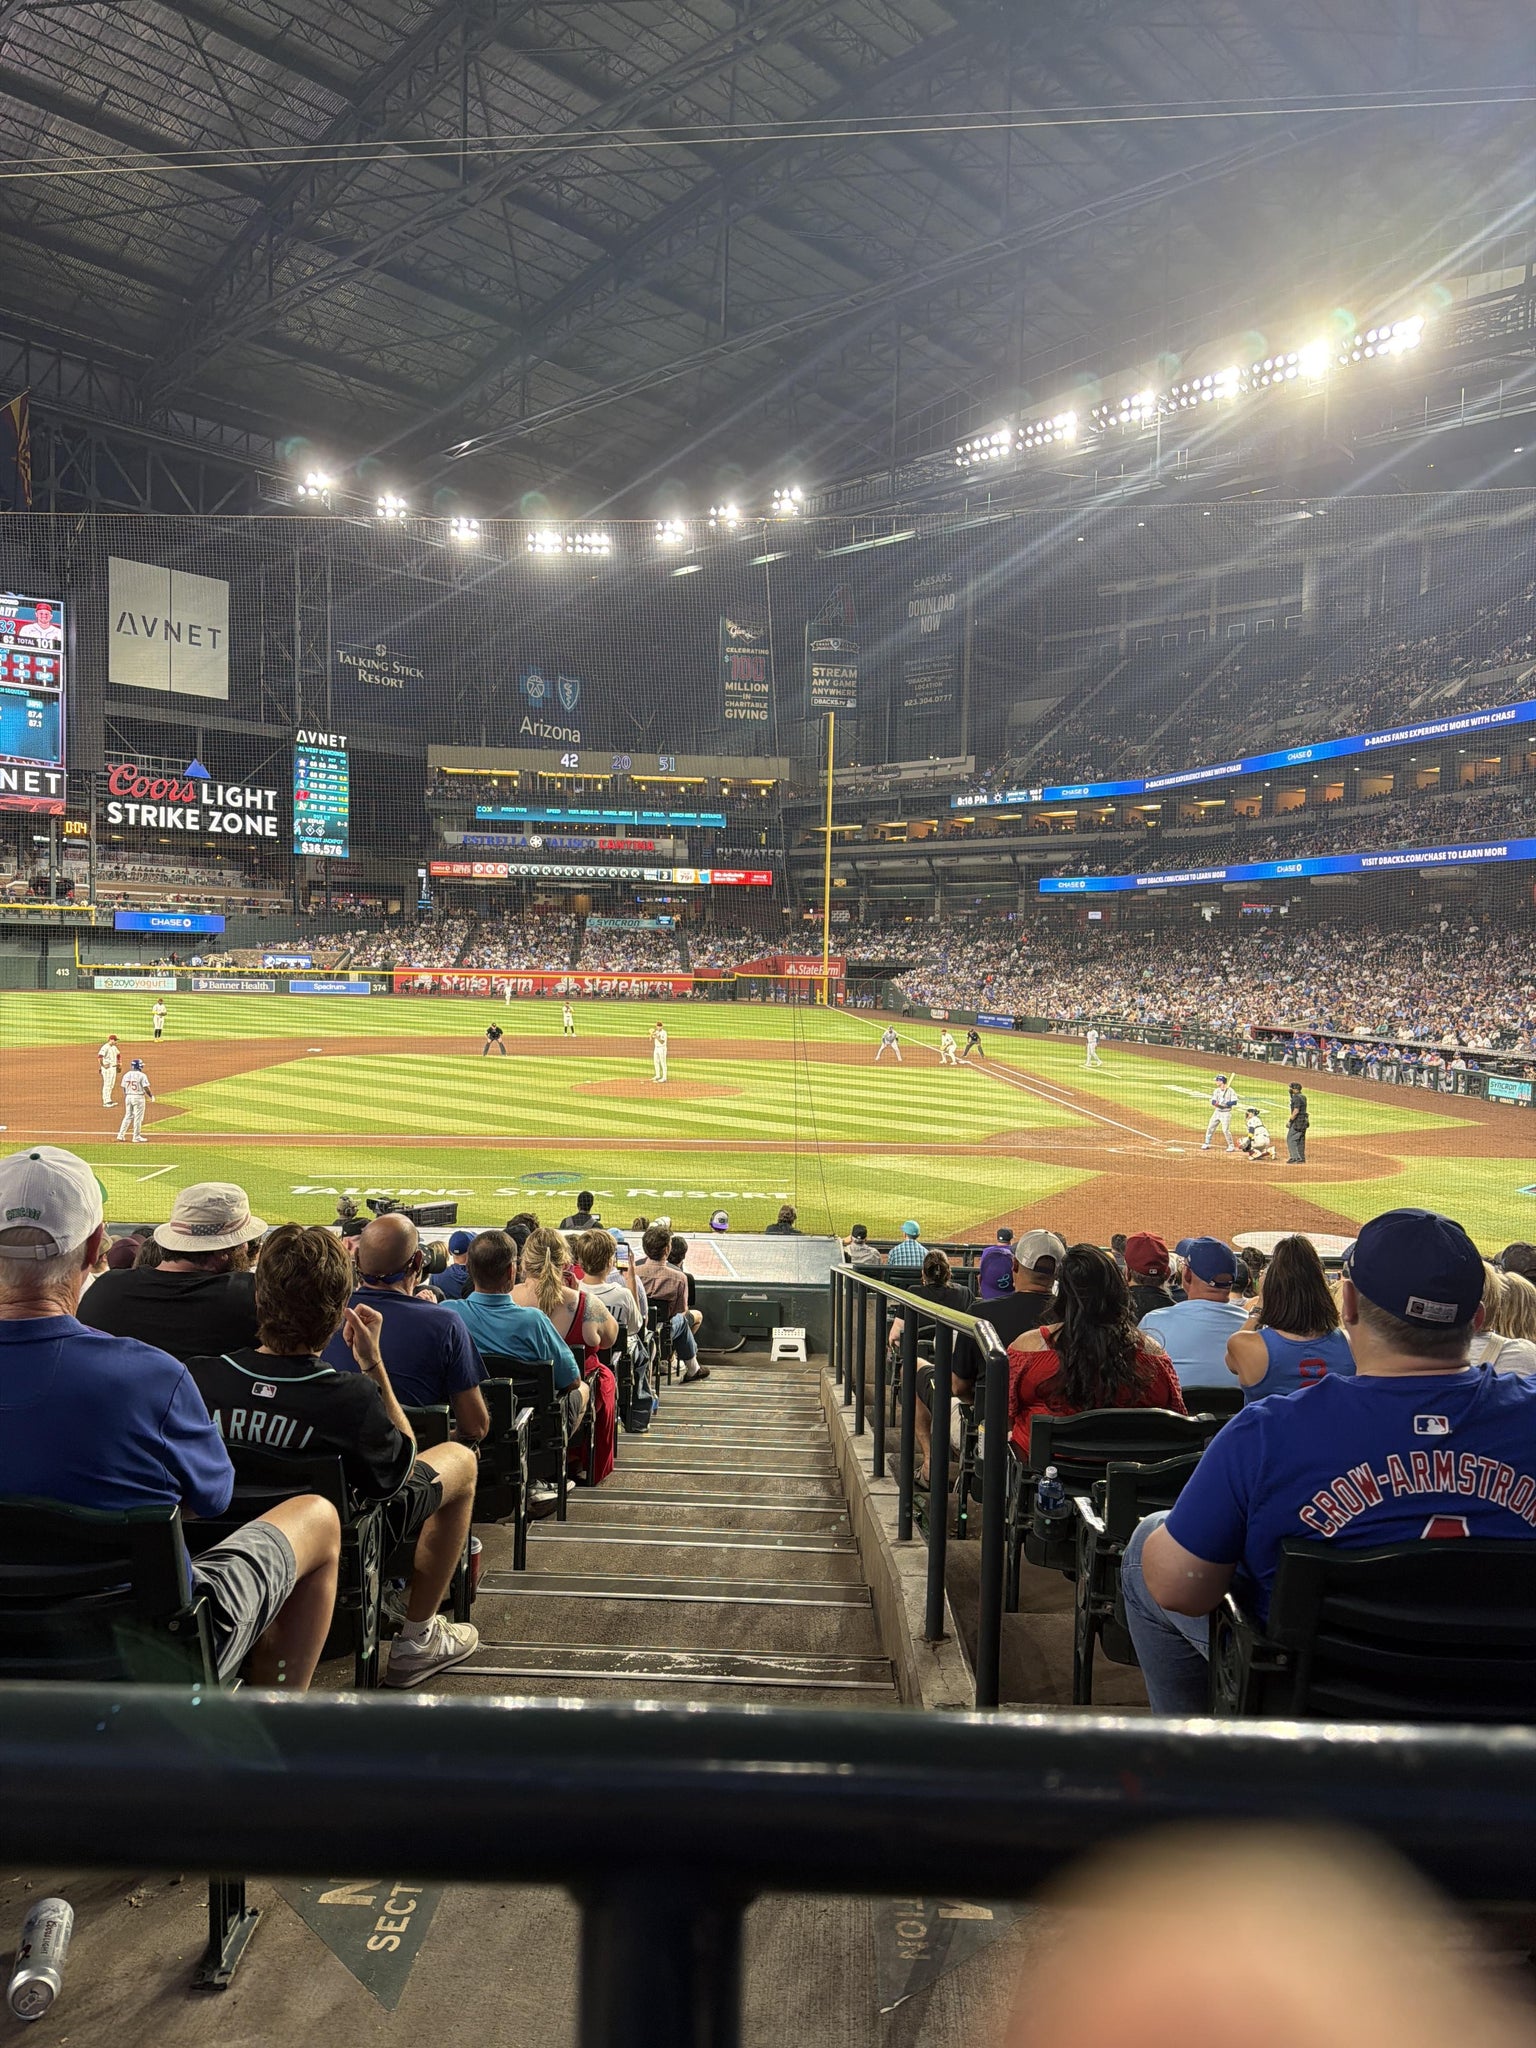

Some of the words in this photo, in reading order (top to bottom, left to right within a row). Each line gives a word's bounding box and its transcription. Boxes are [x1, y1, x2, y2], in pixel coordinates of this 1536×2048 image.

[909, 594, 955, 618] DOWNLOAD
[117, 611, 221, 650] AVNET
[921, 614, 941, 634] NOW
[17, 637, 35, 647] TOTAL
[36, 639, 54, 650] 101
[725, 647, 769, 655] CELEBRATING
[337, 650, 389, 672] TALKING
[393, 661, 425, 679] STICK
[358, 668, 405, 688] RESORT
[812, 667, 857, 678] STREAM
[725, 682, 768, 692] MILLION
[812, 688, 857, 696] ANYWHERE
[725, 709, 768, 720] GIVING
[519, 716, 582, 744] Arizona
[1365, 734, 1391, 746] D-BACKS
[1391, 732, 1408, 742] FANS
[1409, 724, 1448, 739] EXPERIENCE
[1449, 720, 1469, 731] MORE
[1470, 715, 1491, 726] WITH
[1491, 710, 1516, 723] CHASE
[296, 729, 347, 749] AVNET
[560, 754, 579, 768] 42
[1287, 751, 1306, 761] CHASE
[659, 757, 676, 773] 51
[0, 769, 62, 795] NET
[107, 763, 197, 803] Coors
[202, 782, 278, 812] LIGHT
[975, 794, 988, 804] PM
[1061, 788, 1082, 796] CHASE
[107, 802, 200, 831] STRIKE
[208, 812, 278, 837] ZONE
[301, 841, 343, 855] $36,576
[463, 835, 527, 847] ESTRELLA
[545, 837, 596, 849] JALISCO
[598, 839, 655, 851] CANTINA
[1362, 857, 1378, 867] VISIT
[1378, 850, 1447, 866] DBACKS.COM/CHASE
[1448, 850, 1457, 861] TO
[1458, 848, 1484, 860] LEARN
[1484, 846, 1507, 857] MORE
[1276, 865, 1296, 874] CHASE
[1058, 881, 1079, 889] CHASE
[151, 918, 182, 926] CHASE
[597, 919, 640, 928] SYNCRON
[55, 968, 70, 977] 413
[798, 964, 818, 975] State
[818, 965, 839, 977] Frm
[209, 981, 240, 990] Banner
[241, 981, 269, 990] Health
[313, 983, 344, 992] Spectrum
[372, 984, 387, 992] 374
[126, 1080, 137, 1091] 75
[290, 1185, 475, 1197] TALKING
[489, 1187, 616, 1199] STICK
[617, 1188, 796, 1200] RESORT
[210, 1408, 315, 1450] ARROLL
[367, 1881, 424, 1952] SECT
[892, 1896, 931, 1960] TION
